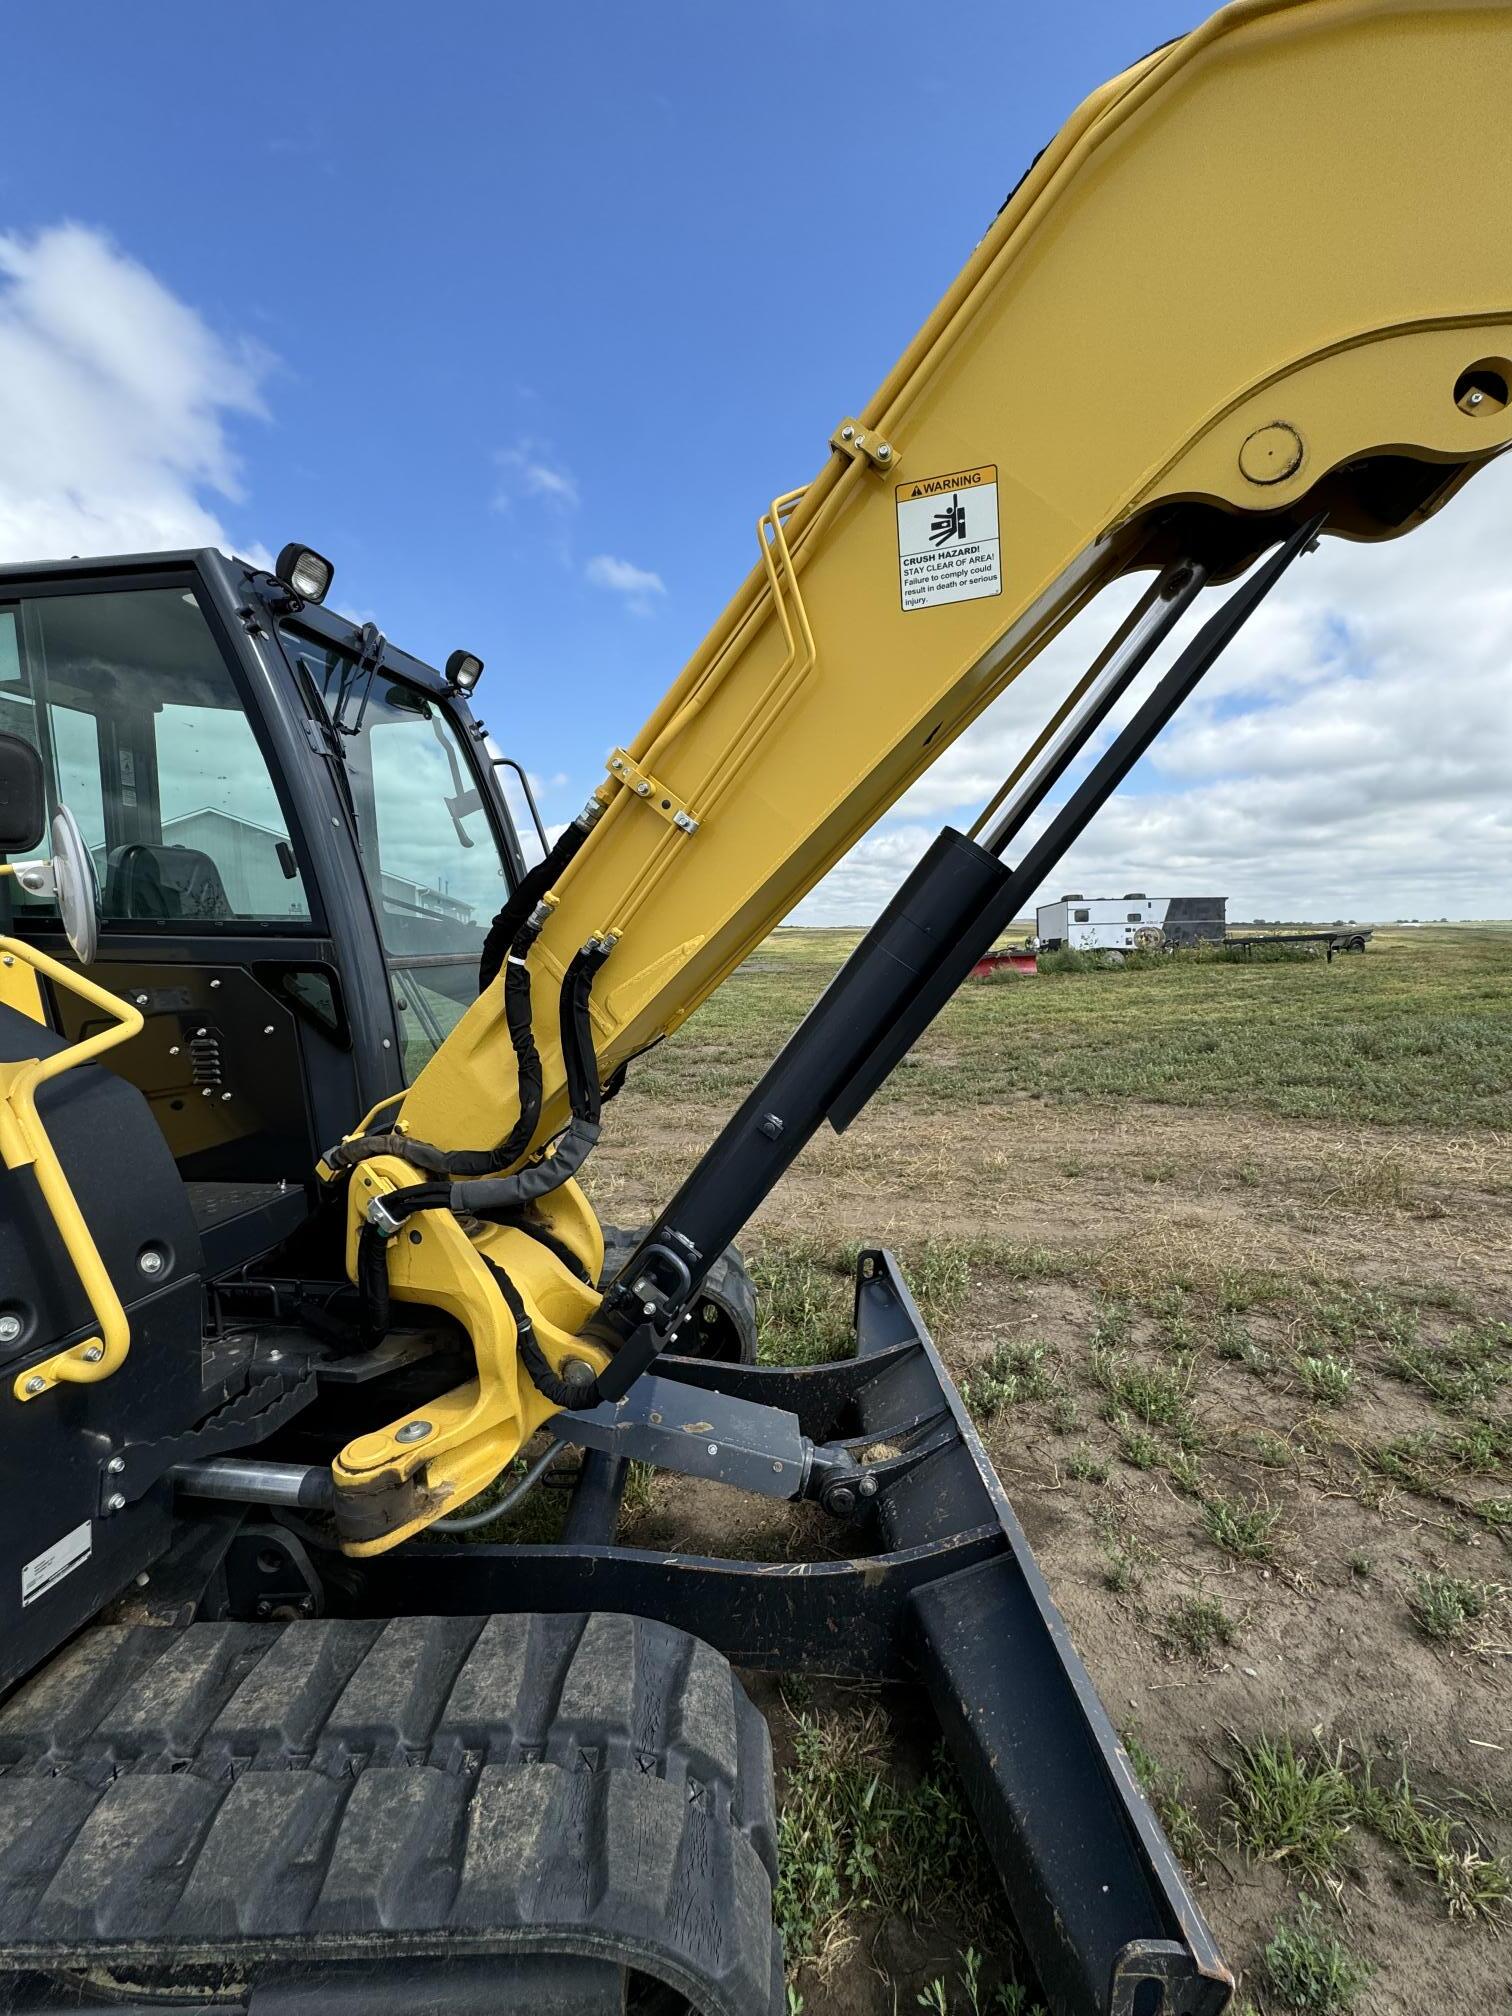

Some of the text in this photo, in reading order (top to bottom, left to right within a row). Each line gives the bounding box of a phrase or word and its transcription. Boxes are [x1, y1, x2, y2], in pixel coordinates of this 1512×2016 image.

[924, 473, 981, 493] WARNING
[904, 546, 980, 566] CRUSH HAZARD!
[904, 567, 924, 576] STAY
[927, 561, 954, 572] CLEAR
[969, 553, 994, 564] AREA!
[905, 576, 929, 586] Failure
[941, 569, 968, 580] comply
[970, 564, 991, 574] could
[905, 586, 926, 596] result
[937, 581, 957, 590] death
[969, 575, 997, 584] serious
[906, 597, 928, 606] injury.
